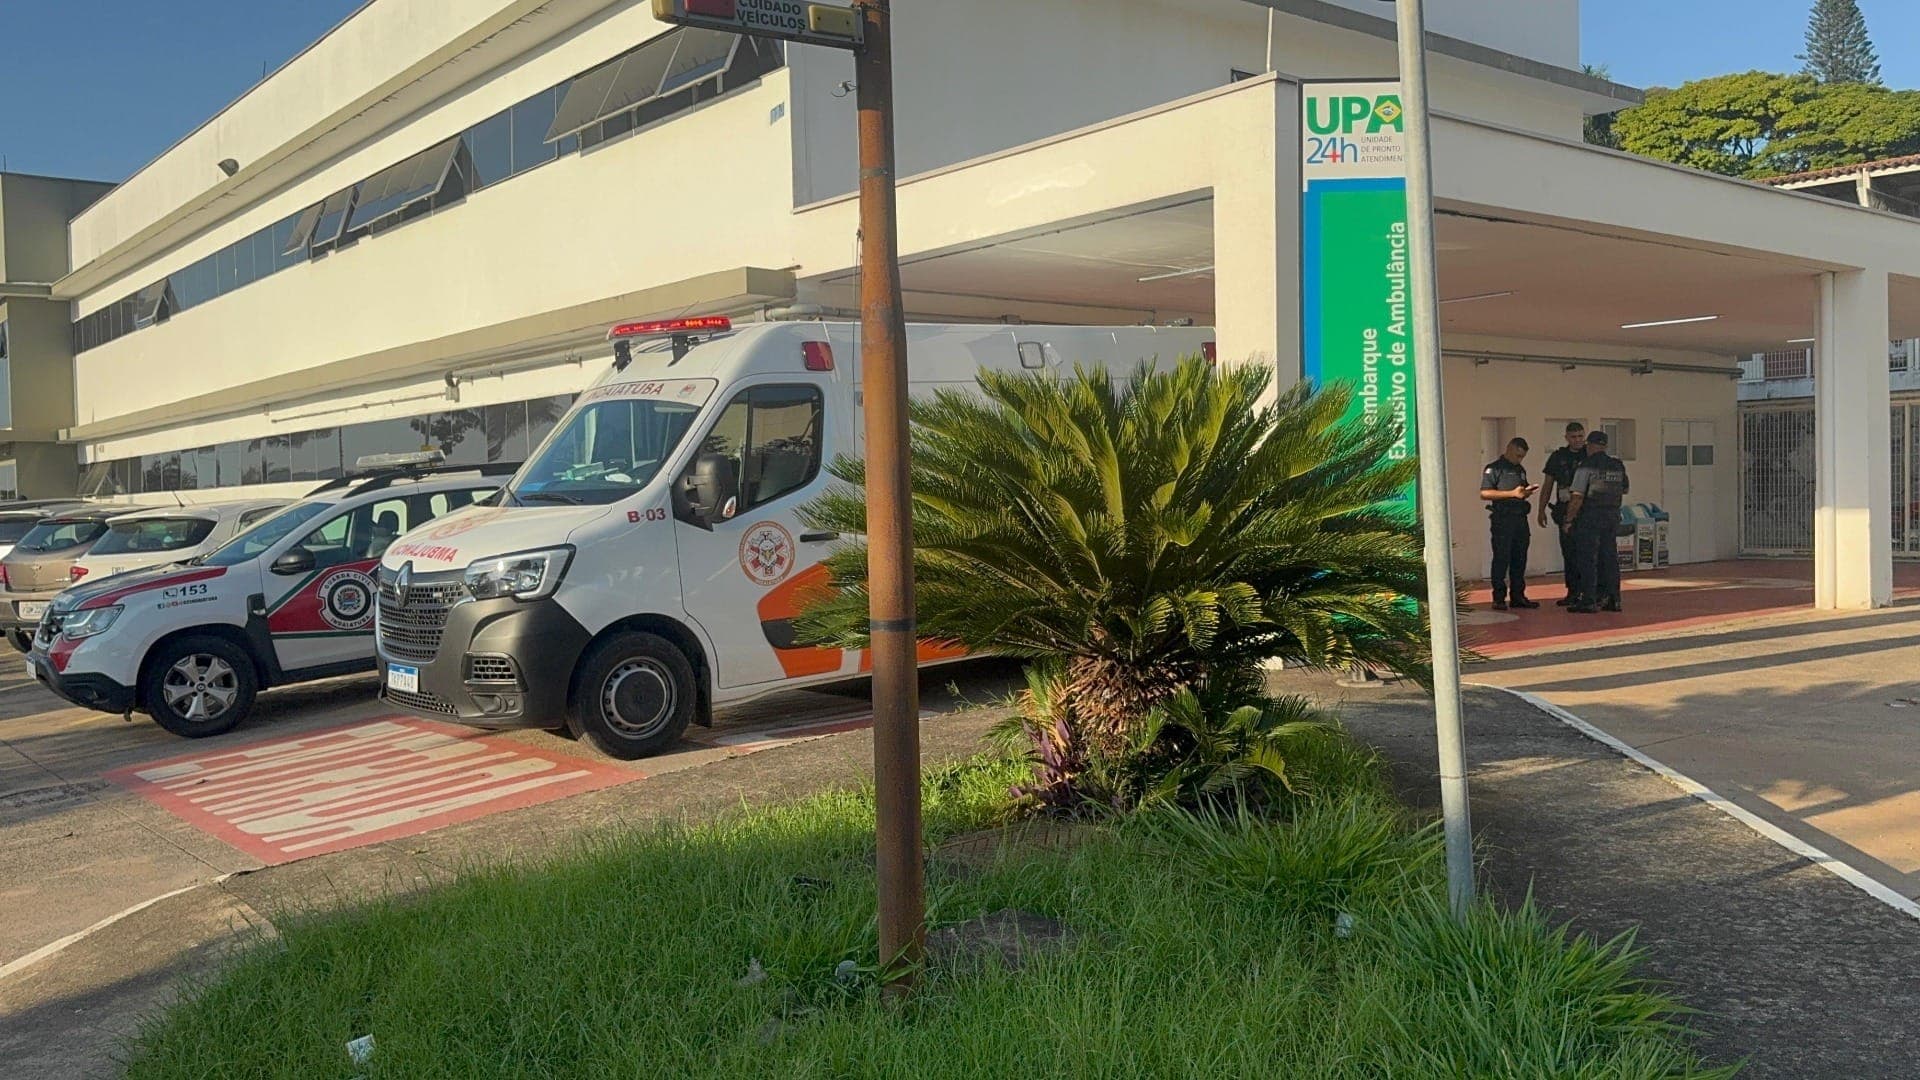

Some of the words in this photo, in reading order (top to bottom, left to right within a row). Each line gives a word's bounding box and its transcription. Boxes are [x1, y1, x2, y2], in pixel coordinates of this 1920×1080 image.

[738, 0, 801, 15] CUIDADO
[1306, 94, 1404, 135] UPA
[1306, 136, 1358, 164] 24h
[1360, 135, 1393, 143] UNIDADE
[1360, 145, 1370, 153] DE
[1372, 145, 1401, 153] PRONTO
[1360, 154, 1403, 163] ATENDIMEN
[1385, 222, 1405, 336] Ambulância
[1386, 342, 1406, 366] de
[1358, 328, 1382, 444] embarque
[180, 584, 208, 596] 153
[133, 720, 593, 853] ENTRADA
